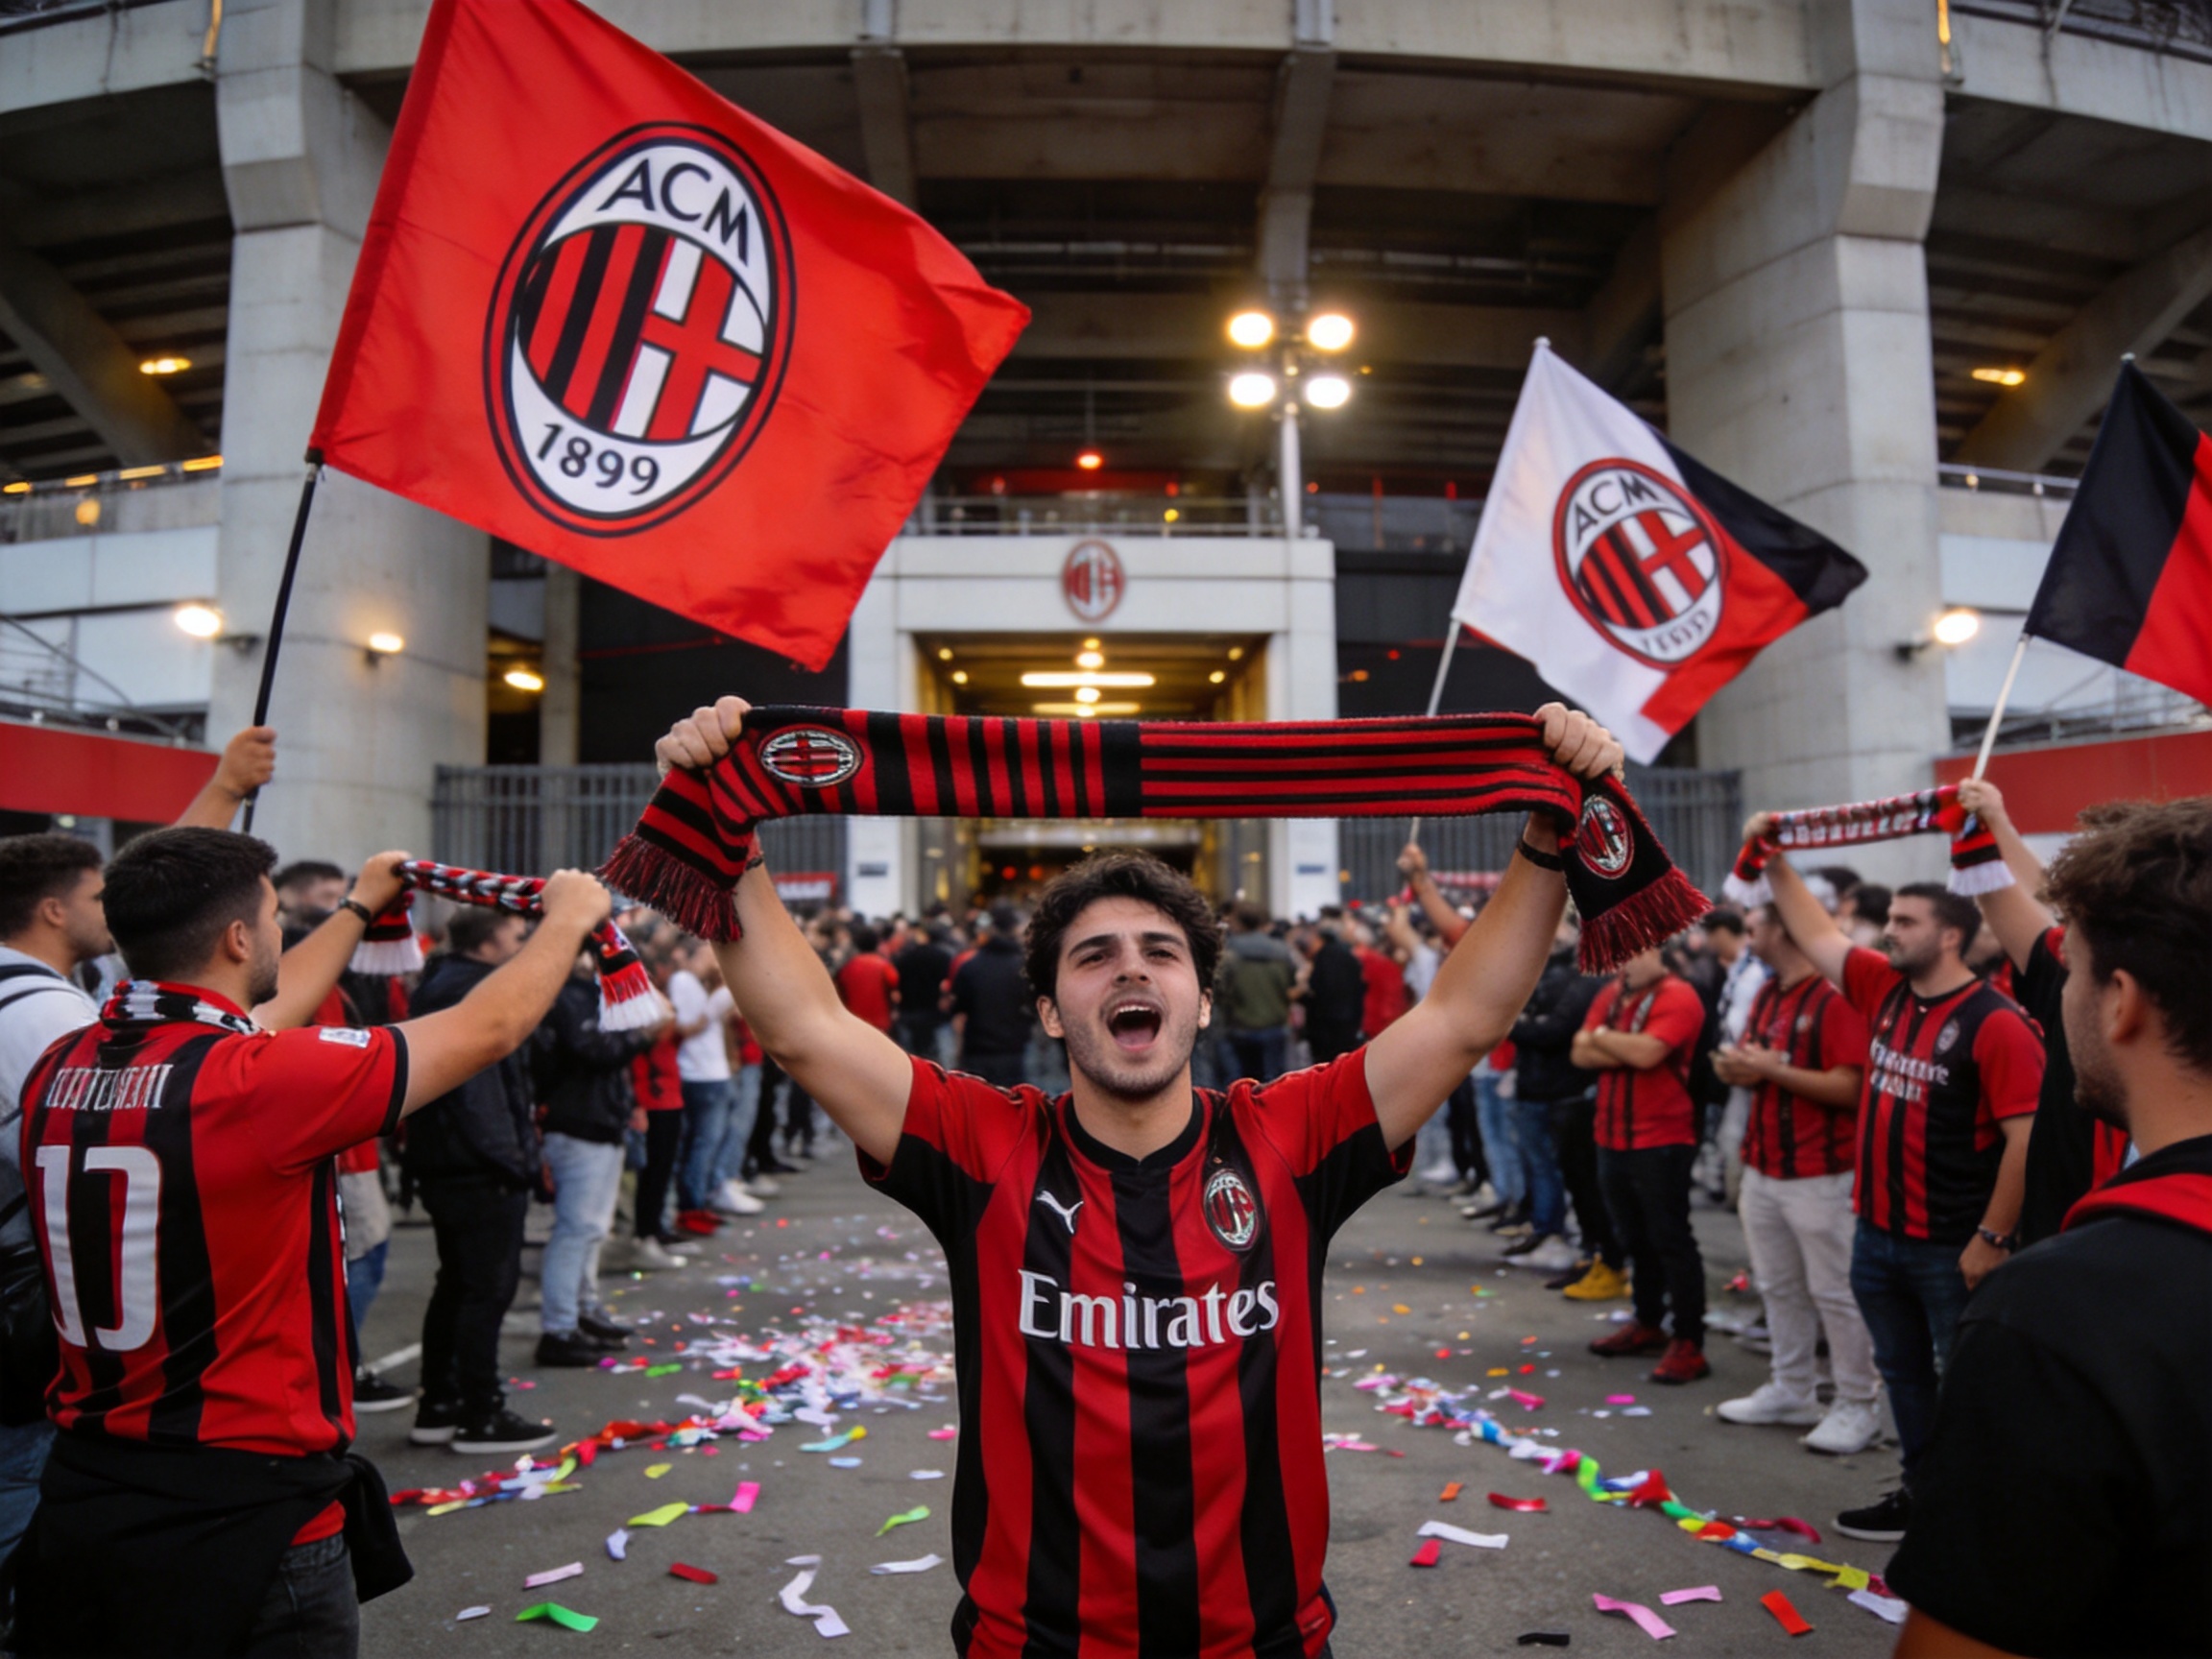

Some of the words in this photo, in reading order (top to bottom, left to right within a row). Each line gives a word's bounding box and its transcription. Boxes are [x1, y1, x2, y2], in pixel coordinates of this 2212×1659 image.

[595, 158, 749, 267] ACM
[536, 422, 661, 495] 1899
[1575, 474, 1661, 547] ACM
[1018, 1268, 1279, 1349] Emirates
